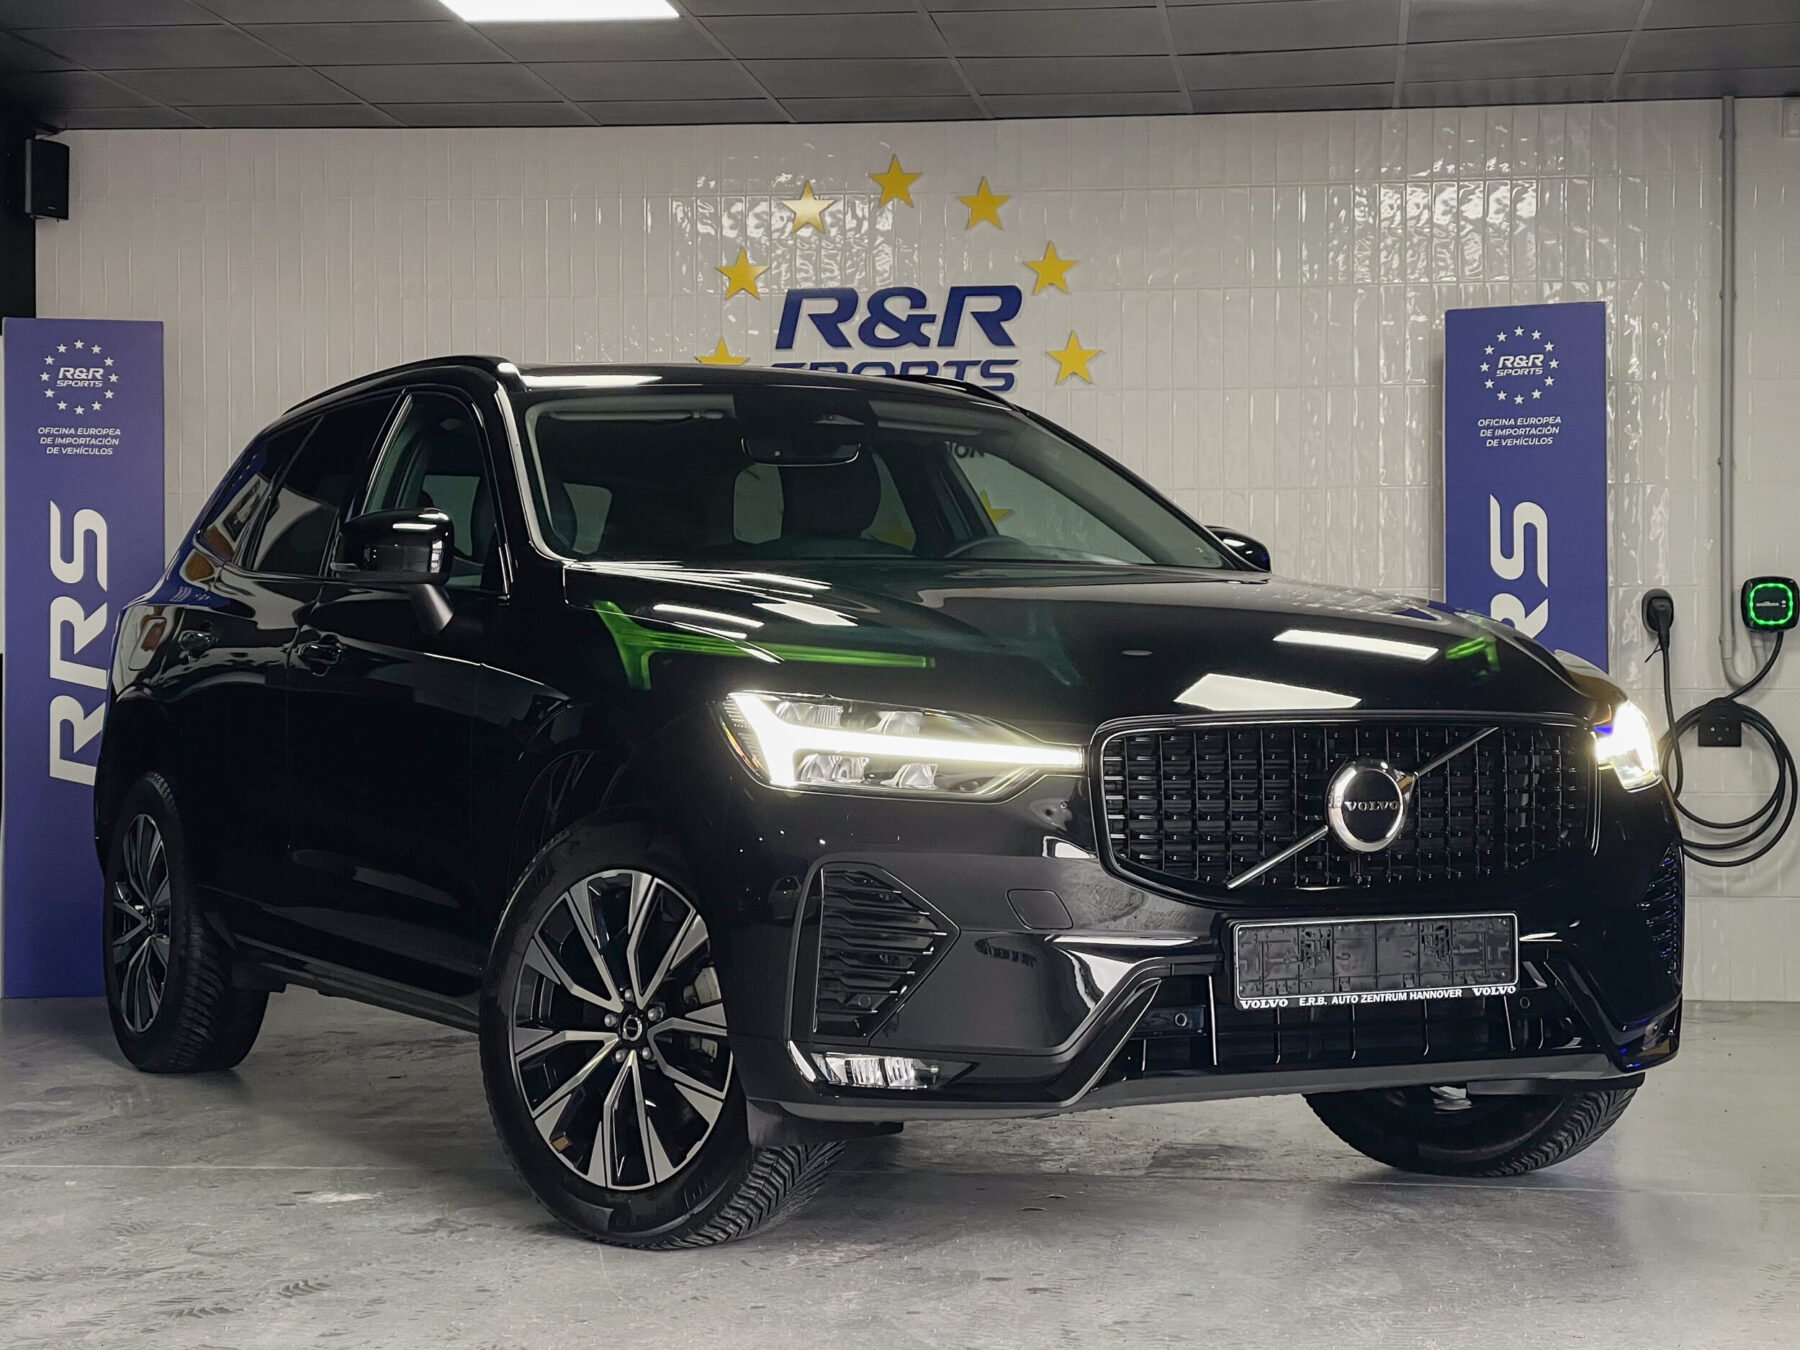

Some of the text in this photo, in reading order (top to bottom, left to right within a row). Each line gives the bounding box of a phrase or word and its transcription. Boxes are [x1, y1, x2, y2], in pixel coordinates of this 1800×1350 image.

[775, 284, 1023, 350] R&R
[1498, 354, 1544, 368] R&R
[58, 367, 104, 379] R&R
[1496, 367, 1544, 377] SPORTS
[1478, 416, 1561, 427] OFICINA EUROPEA
[77, 427, 121, 436] EUROPEA
[1480, 425, 1559, 437] DE IMPORTACIÓN
[55, 437, 119, 445] IMPORTACIÓN
[1486, 437, 1553, 447] DE VEHÍCULOS
[61, 446, 113, 455] VEHÍCULOS
[50, 500, 108, 786] RRS
[1344, 801, 1398, 811] VOLVO
[1240, 985, 1517, 1009] VOLVO E.R.B. AUTO ZENTRUM HANNOVER VOLVO
